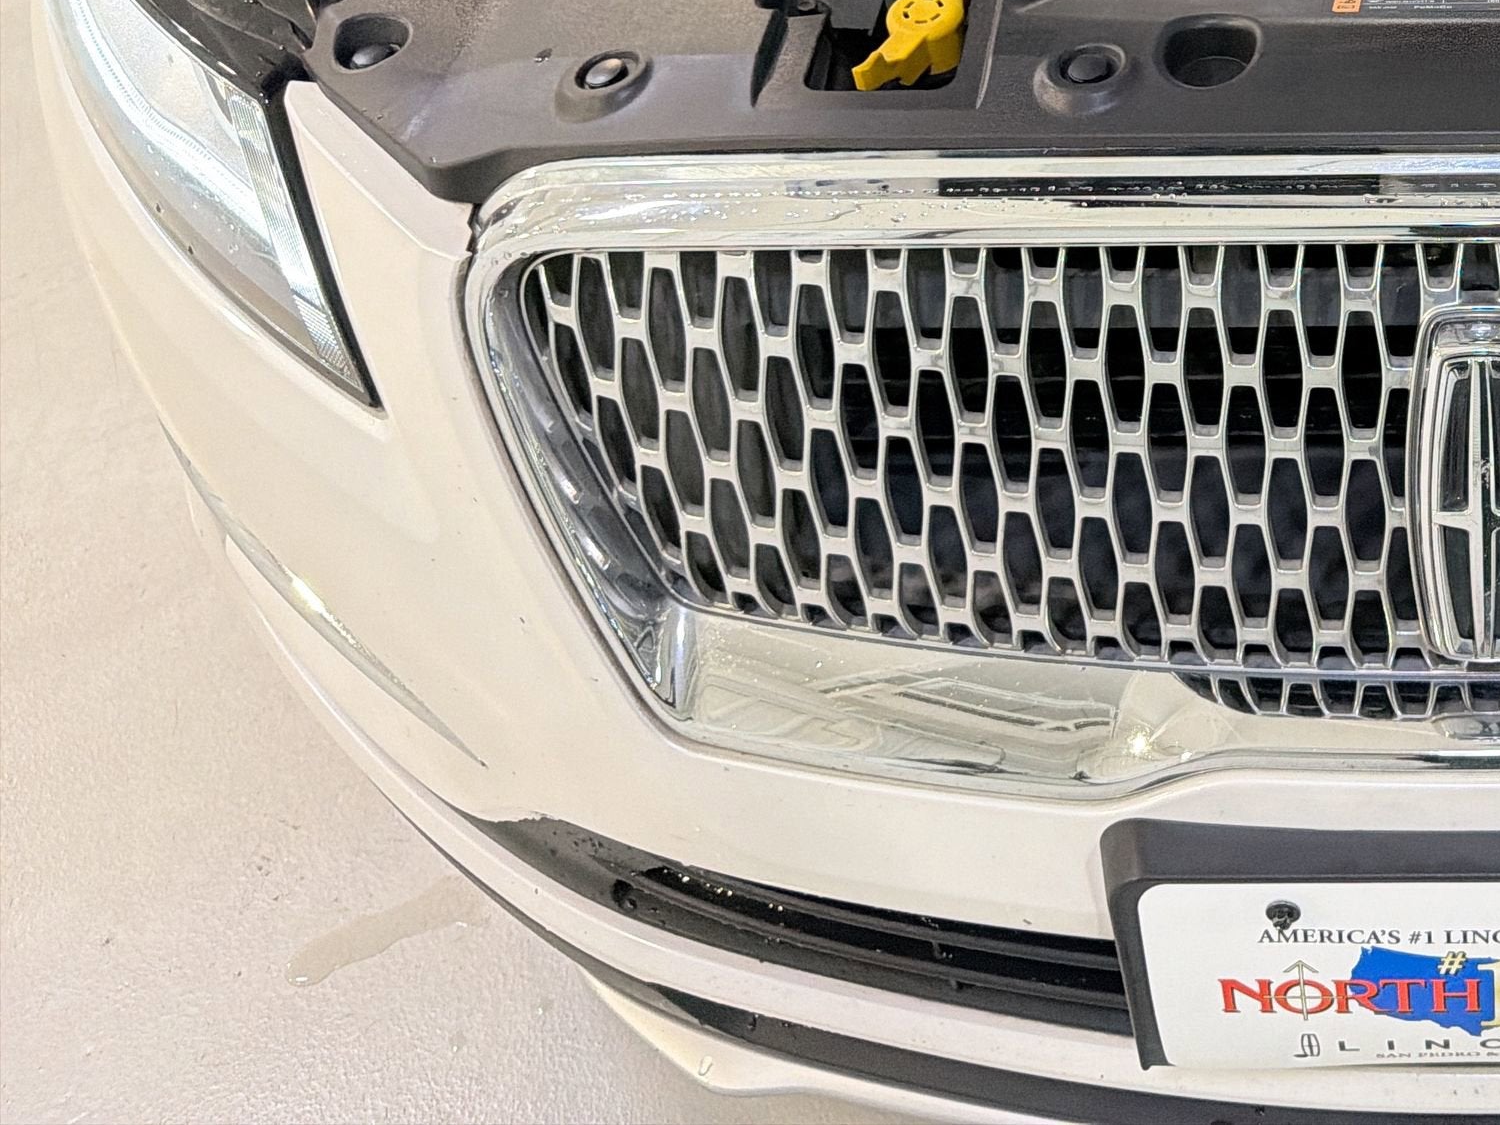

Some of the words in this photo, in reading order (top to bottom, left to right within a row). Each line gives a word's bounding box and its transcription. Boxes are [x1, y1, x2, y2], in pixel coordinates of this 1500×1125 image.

[1257, 928, 1401, 944] AMERICA'S
[1408, 930, 1434, 945] #1
[1217, 977, 1483, 1014] NORTH
